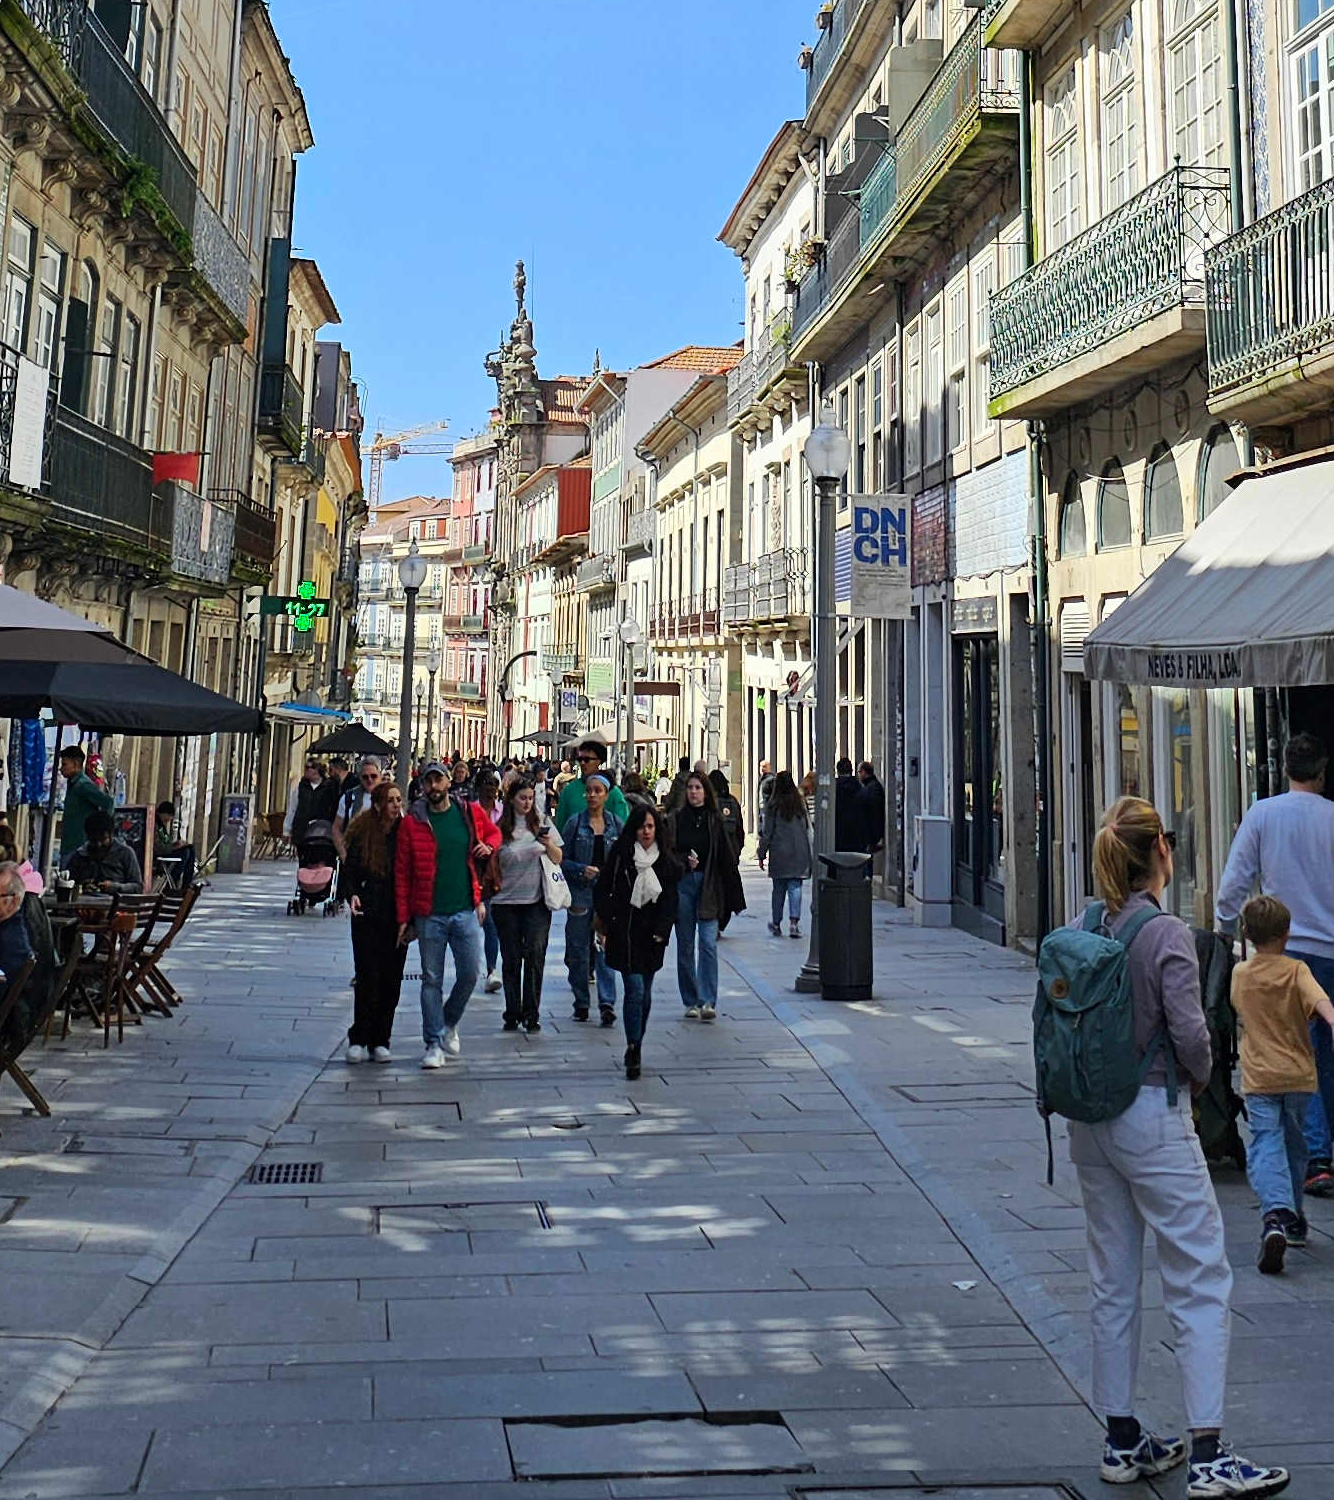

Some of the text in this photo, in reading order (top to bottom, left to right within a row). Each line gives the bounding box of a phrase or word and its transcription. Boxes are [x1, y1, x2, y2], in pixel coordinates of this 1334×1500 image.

[854, 506, 907, 536] DN
[853, 534, 908, 567] CH
[1148, 654, 1176, 679] NEVES
[1187, 653, 1217, 684] FILHA,
